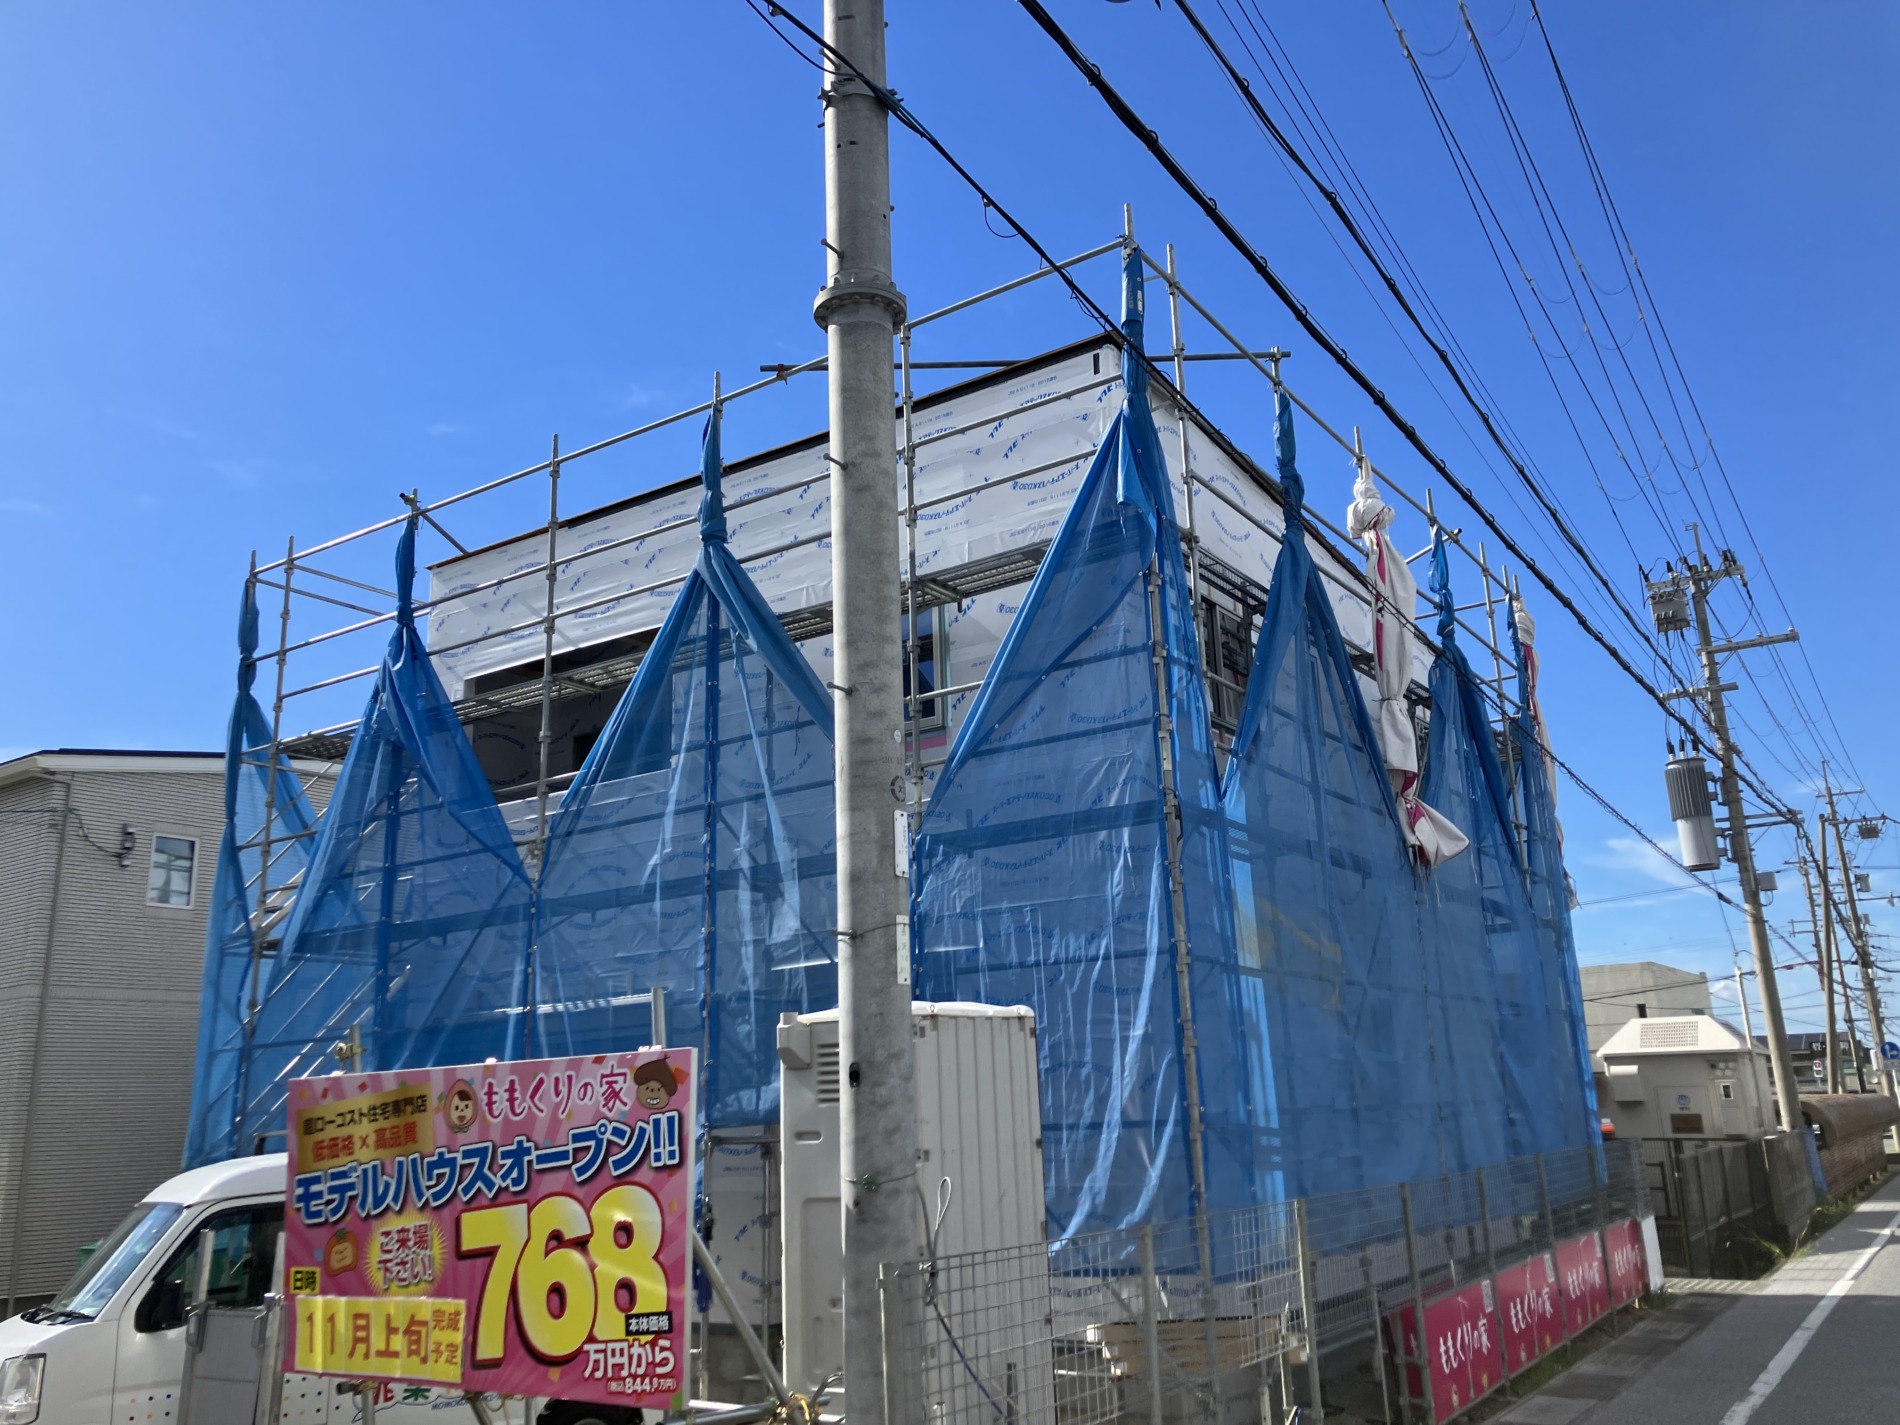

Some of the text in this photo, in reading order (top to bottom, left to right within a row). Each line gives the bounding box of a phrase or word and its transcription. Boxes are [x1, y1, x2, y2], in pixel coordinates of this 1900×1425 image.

[482, 1064, 629, 1124] ももくりの家
[380, 1225, 432, 1253] ご来場
[291, 1271, 318, 1294] 日時
[456, 1184, 669, 1370] 768
[432, 1308, 460, 1334] 完成
[628, 1314, 670, 1333] 本体価格
[1509, 1286, 1554, 1334] ももくりの家
[431, 1343, 460, 1368] 予定
[583, 1338, 676, 1380] 万円から
[1439, 1314, 1492, 1374] ももくりの家
